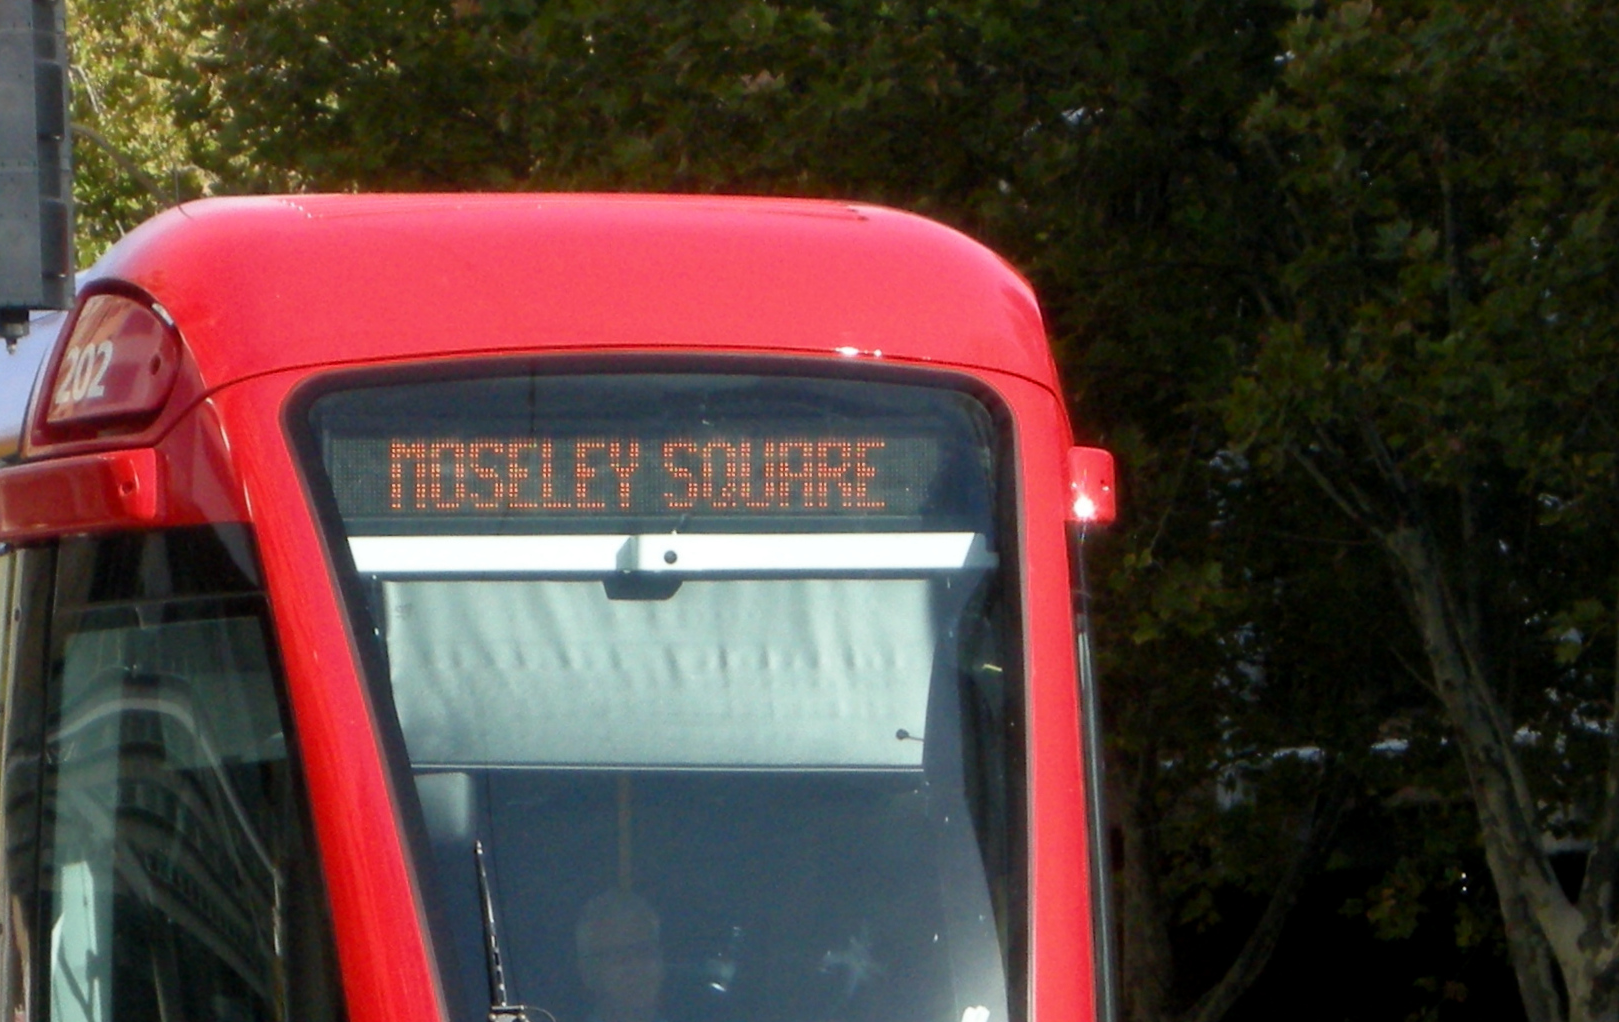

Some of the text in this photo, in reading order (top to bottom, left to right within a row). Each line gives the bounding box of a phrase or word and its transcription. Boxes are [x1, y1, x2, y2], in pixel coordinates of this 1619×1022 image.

[55, 340, 113, 404] 202
[390, 437, 886, 508] MOSELEY SQUARE
